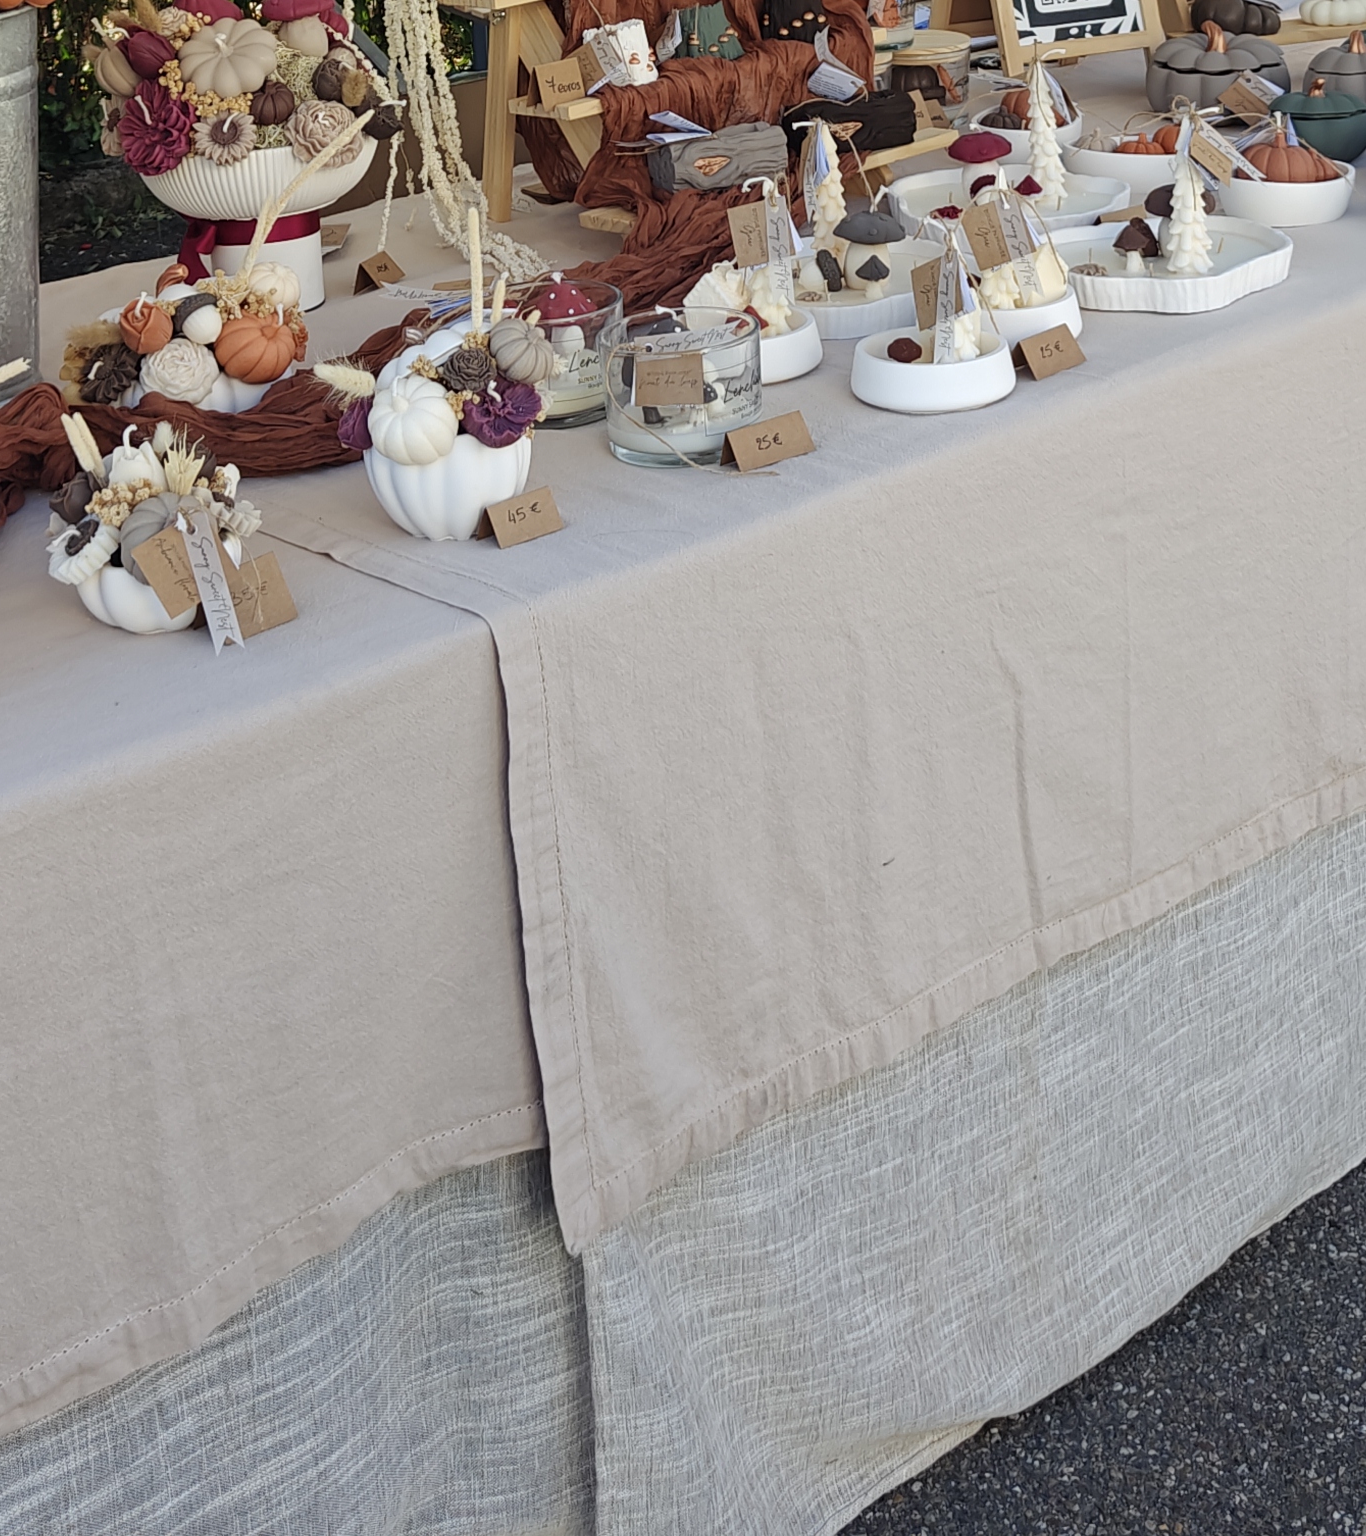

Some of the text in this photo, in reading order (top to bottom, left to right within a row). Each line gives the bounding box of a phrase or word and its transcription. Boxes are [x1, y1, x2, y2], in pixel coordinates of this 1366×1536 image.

[545, 75, 582, 93] 7 euros
[655, 337, 682, 351] Sunny
[755, 432, 782, 451] 25€
[191, 536, 215, 570] Sunny
